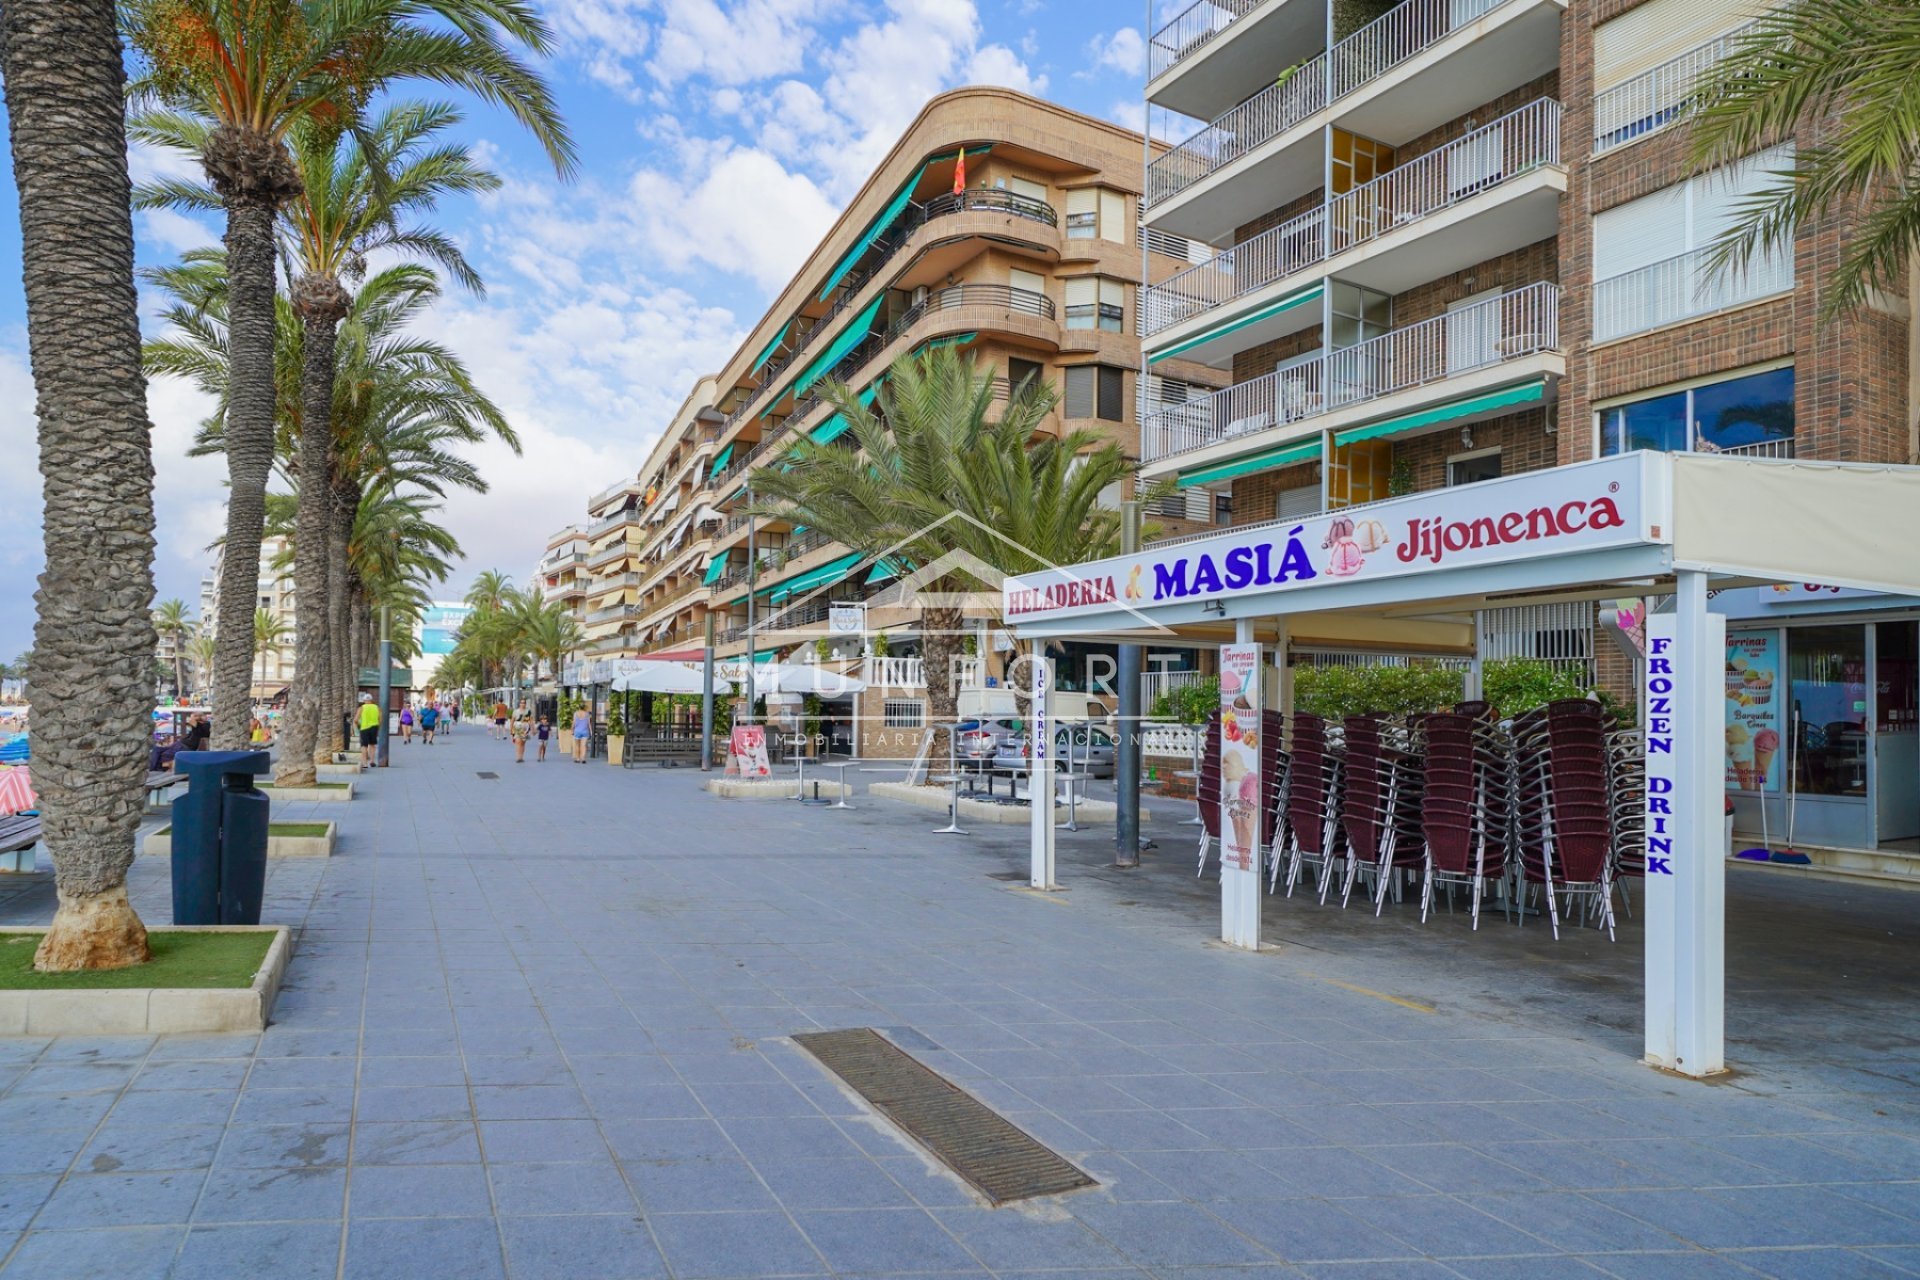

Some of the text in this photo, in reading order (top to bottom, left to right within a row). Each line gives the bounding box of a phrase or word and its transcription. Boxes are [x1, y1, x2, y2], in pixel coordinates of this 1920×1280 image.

[1008, 497, 1625, 615] HELADERIA MASIÁ Jijonenca
[1222, 647, 1255, 663] Tarrinas
[1037, 710, 1045, 760] CREAM
[1647, 637, 1673, 875] FROZEN DRINK
[1749, 775, 1768, 784] 194
